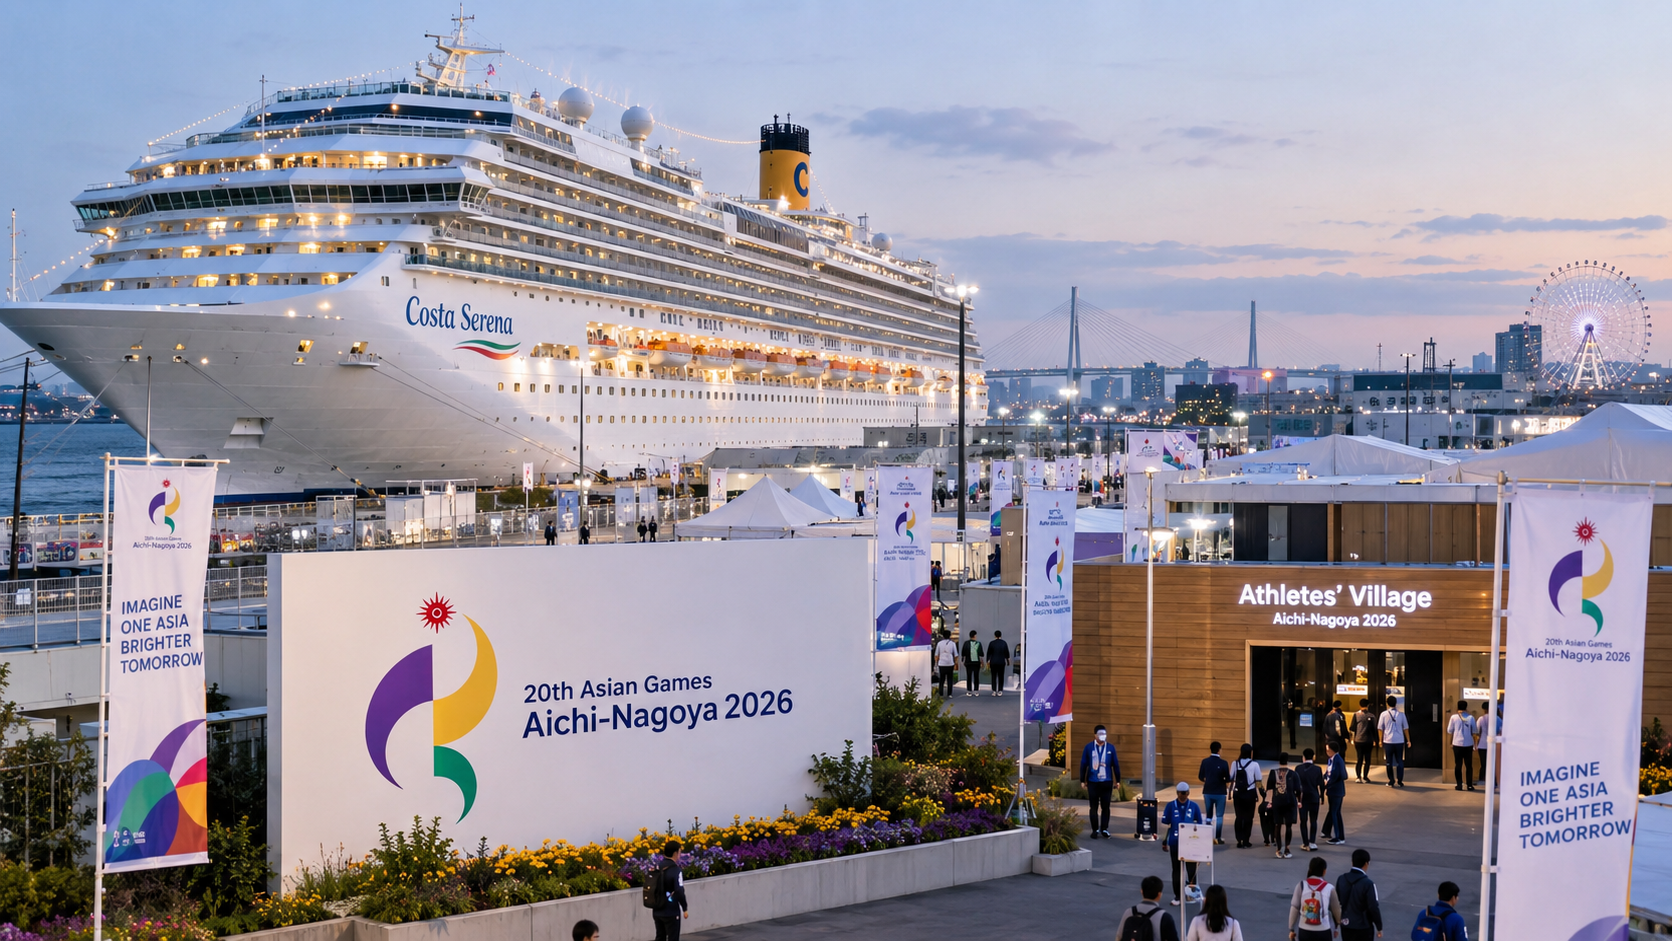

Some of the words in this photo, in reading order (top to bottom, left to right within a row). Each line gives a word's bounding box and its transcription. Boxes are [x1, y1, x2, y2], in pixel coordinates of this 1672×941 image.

[405, 295, 456, 330] Costa
[460, 303, 514, 335] Serena
[121, 594, 182, 615] IMAGINE
[1348, 584, 1433, 613] Village
[121, 617, 152, 635] ONE
[155, 613, 190, 631] ASIA
[1272, 612, 1360, 629] Aichi-Nagoya
[1362, 613, 1397, 628] 2026
[121, 633, 192, 655] BRIGHTER
[1525, 647, 1603, 663] Aichi-Nagoya
[1605, 650, 1631, 662] 2026
[1545, 638, 1563, 647] 20th
[1564, 639, 1586, 647] Asian
[1587, 640, 1613, 649] Games
[120, 651, 204, 674] TOMORROW
[523, 680, 574, 704] 20th
[580, 677, 638, 699] Asian
[644, 674, 713, 695] Games
[521, 700, 719, 739] Aichi-Nagoya
[724, 688, 794, 720] 2026
[1520, 761, 1600, 787] IMAGINE
[1519, 788, 1559, 807] ONE
[1565, 781, 1608, 801] ASIA
[1519, 801, 1614, 829] BRIGHTER
[1518, 819, 1632, 849] TOMORROW
